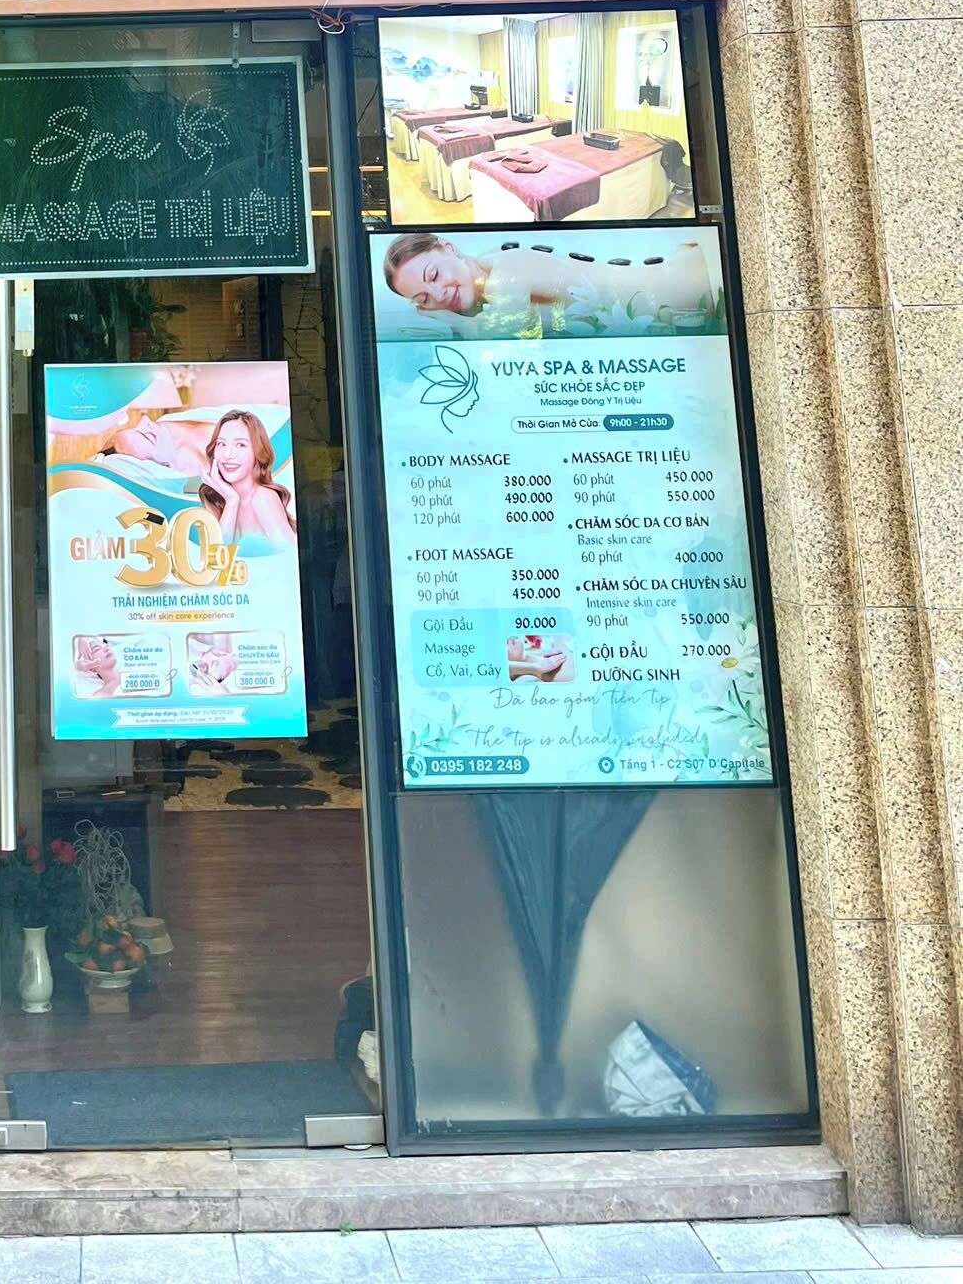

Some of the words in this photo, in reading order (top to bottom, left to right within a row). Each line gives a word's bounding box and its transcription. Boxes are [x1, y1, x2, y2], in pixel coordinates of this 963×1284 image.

[30, 106, 161, 192] Spa
[165, 190, 213, 247] TRỊ
[222, 187, 291, 246] LIỆU
[491, 361, 539, 377] YUYA
[543, 361, 577, 375] SPA
[581, 360, 594, 374] &
[599, 358, 686, 374] MASSAGE
[518, 420, 536, 429] Thời
[538, 420, 560, 428] Gian
[562, 418, 577, 428] Mở
[610, 418, 632, 428] 9h00
[640, 418, 668, 427] 21h30
[409, 455, 445, 467] BODY
[450, 454, 511, 466] MASSAGE
[411, 477, 424, 488] 60
[428, 476, 452, 491] phút
[504, 475, 552, 487] 380.000
[412, 495, 426, 506] 90
[429, 493, 453, 509] phút
[505, 492, 553, 504] 490.000
[70, 530, 125, 561] GIẢM
[116, 507, 248, 588] 30%
[415, 549, 448, 561] FOOT
[452, 548, 514, 560] MASSAGE
[583, 578, 619, 591] CHĂM
[623, 576, 648, 590] SÓC
[651, 579, 668, 590] DA
[671, 576, 720, 589] CHUYÊN
[724, 576, 747, 589] SÂU
[112, 592, 135, 608] TRẢI
[138, 593, 178, 609] NGHIỆM
[180, 594, 209, 606] CHĂM
[212, 592, 233, 605] SÓC
[236, 594, 249, 605] DA
[128, 612, 144, 621] 30%
[146, 612, 157, 620] off
[159, 611, 174, 620] skin
[194, 612, 234, 621] experience
[590, 643, 614, 661] GỘI
[620, 640, 648, 658] ĐẦU
[682, 645, 731, 656] 270.000
[592, 667, 643, 682] DƯỠNG
[647, 669, 680, 681] SINH
[431, 760, 464, 772] 0395
[469, 760, 493, 772] 182
[497, 760, 522, 771] 248
